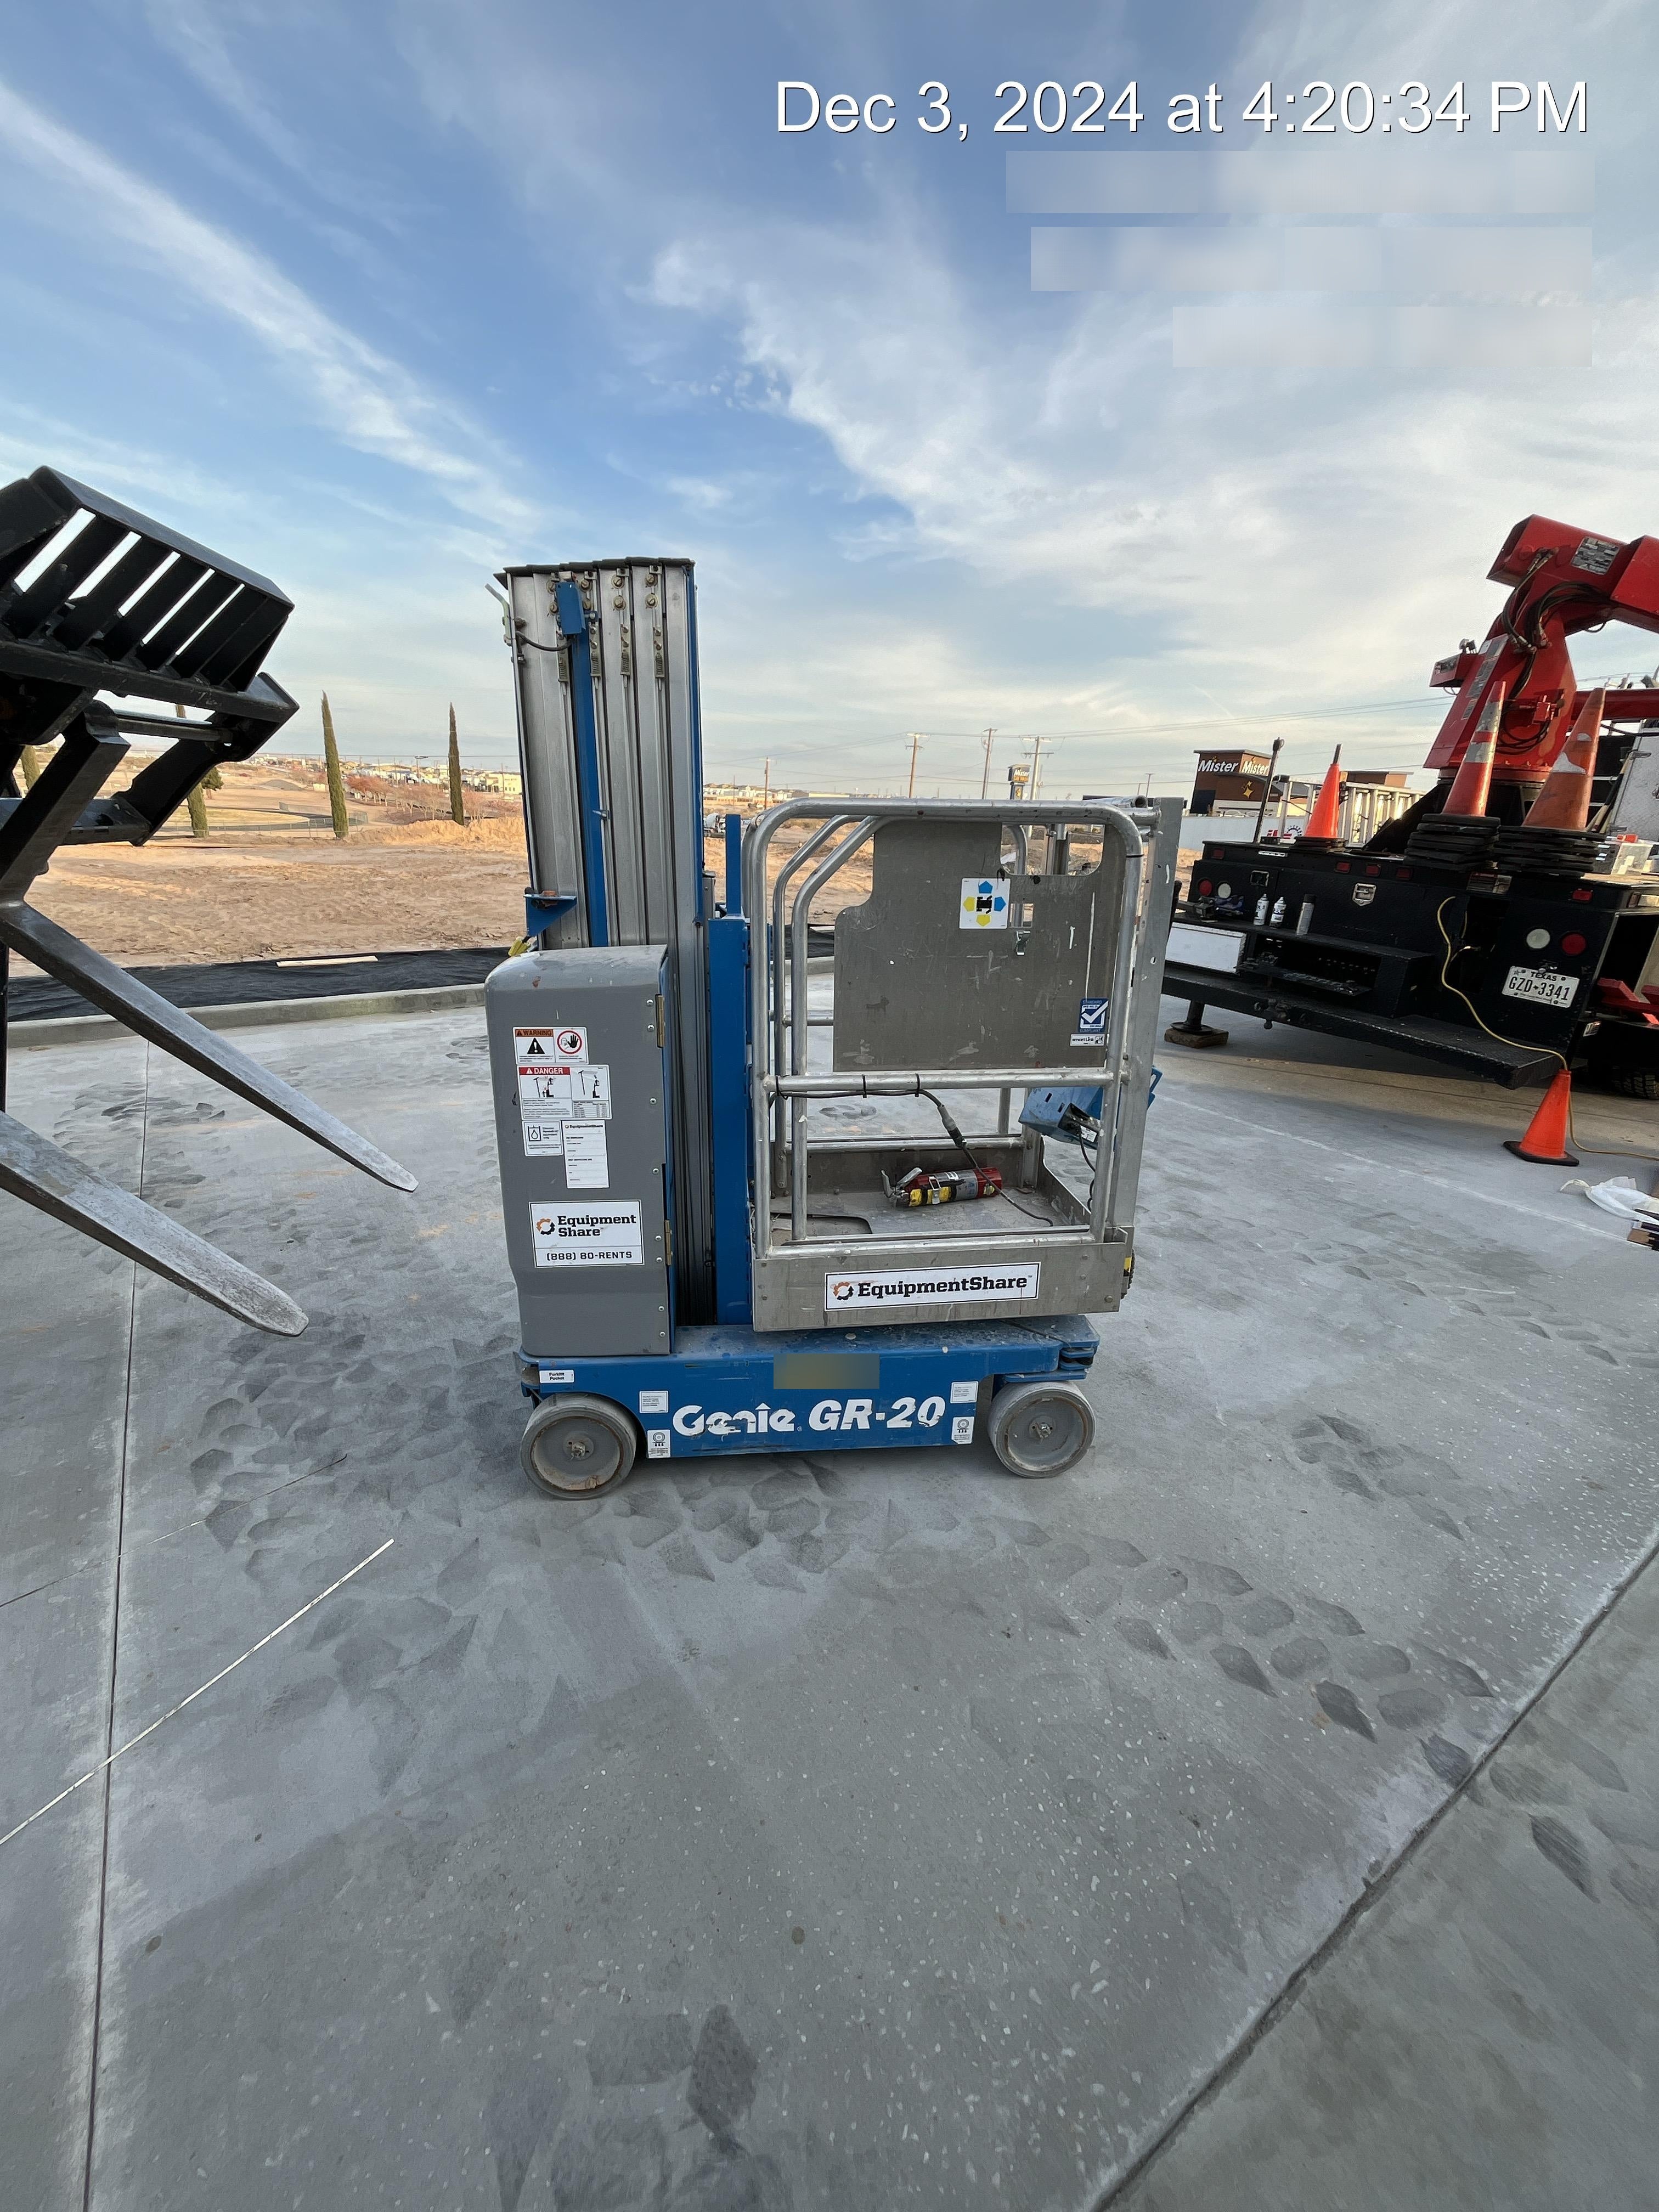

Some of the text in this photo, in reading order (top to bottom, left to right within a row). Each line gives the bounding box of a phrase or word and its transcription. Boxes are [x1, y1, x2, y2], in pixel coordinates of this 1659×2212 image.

[1198, 759, 1239, 772] Mister
[1242, 760, 1269, 775] Mister
[1531, 972, 1557, 981] TEXAS
[557, 1215, 636, 1227] Equipment
[558, 1227, 600, 1237] Share
[547, 1251, 632, 1261] (888) 80-RENTS
[857, 1276, 1028, 1299] EquipmentShare
[673, 1396, 946, 1437] Genie GR-20
